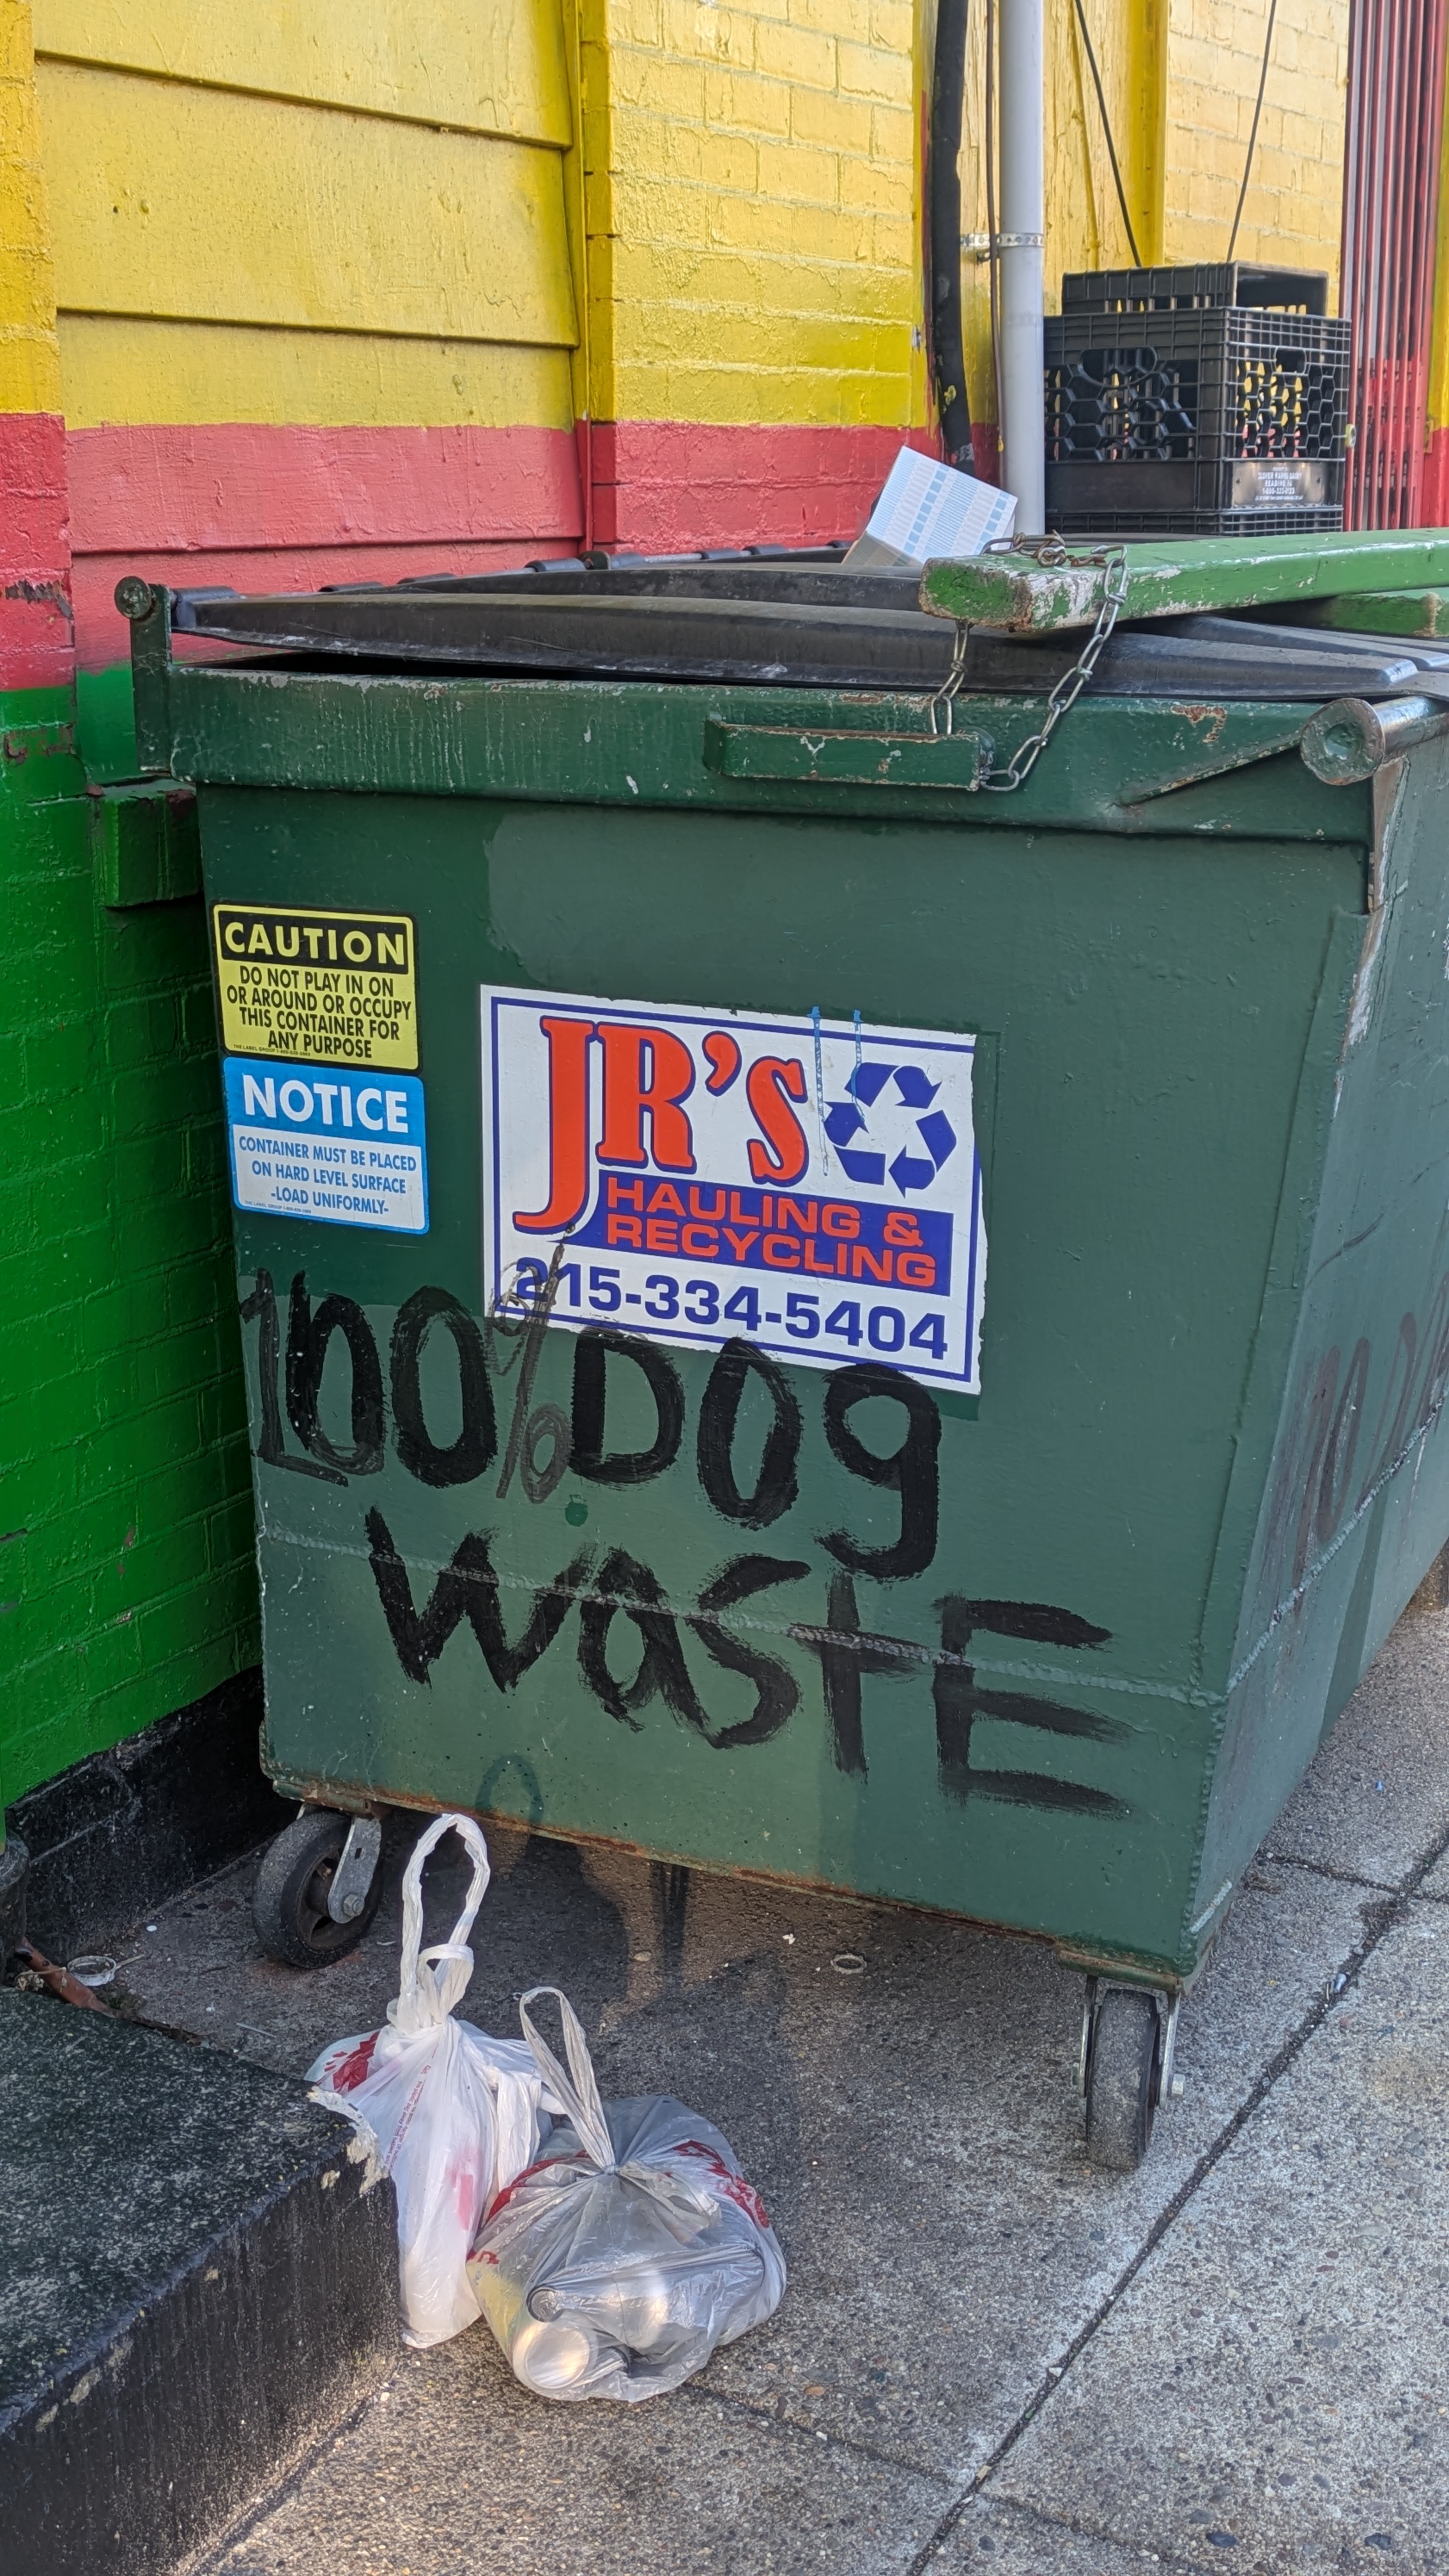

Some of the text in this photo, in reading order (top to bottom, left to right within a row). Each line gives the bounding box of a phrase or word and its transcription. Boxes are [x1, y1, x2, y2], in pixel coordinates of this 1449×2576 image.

[225, 922, 404, 965] CAUTION
[240, 965, 394, 997] DO NOT PLAY IN ON
[227, 986, 411, 1019] OR AROUND OR OCCUPY
[240, 1008, 399, 1040] THIS CONTAINER FOR
[268, 1031, 372, 1057] ANY PURPOSE
[243, 1075, 408, 1133] NOTICE
[239, 1136, 417, 1171] CONTAINER MUST BE PLACED
[252, 1161, 406, 1193] ON HARD LEVEL SURFACE
[272, 1186, 388, 1213] -LOAD UNIFORMLY-
[606, 1177, 924, 1247] HAULING &
[606, 1213, 936, 1287] RECYCLING
[516, 1256, 948, 1360] 215-334-5404
